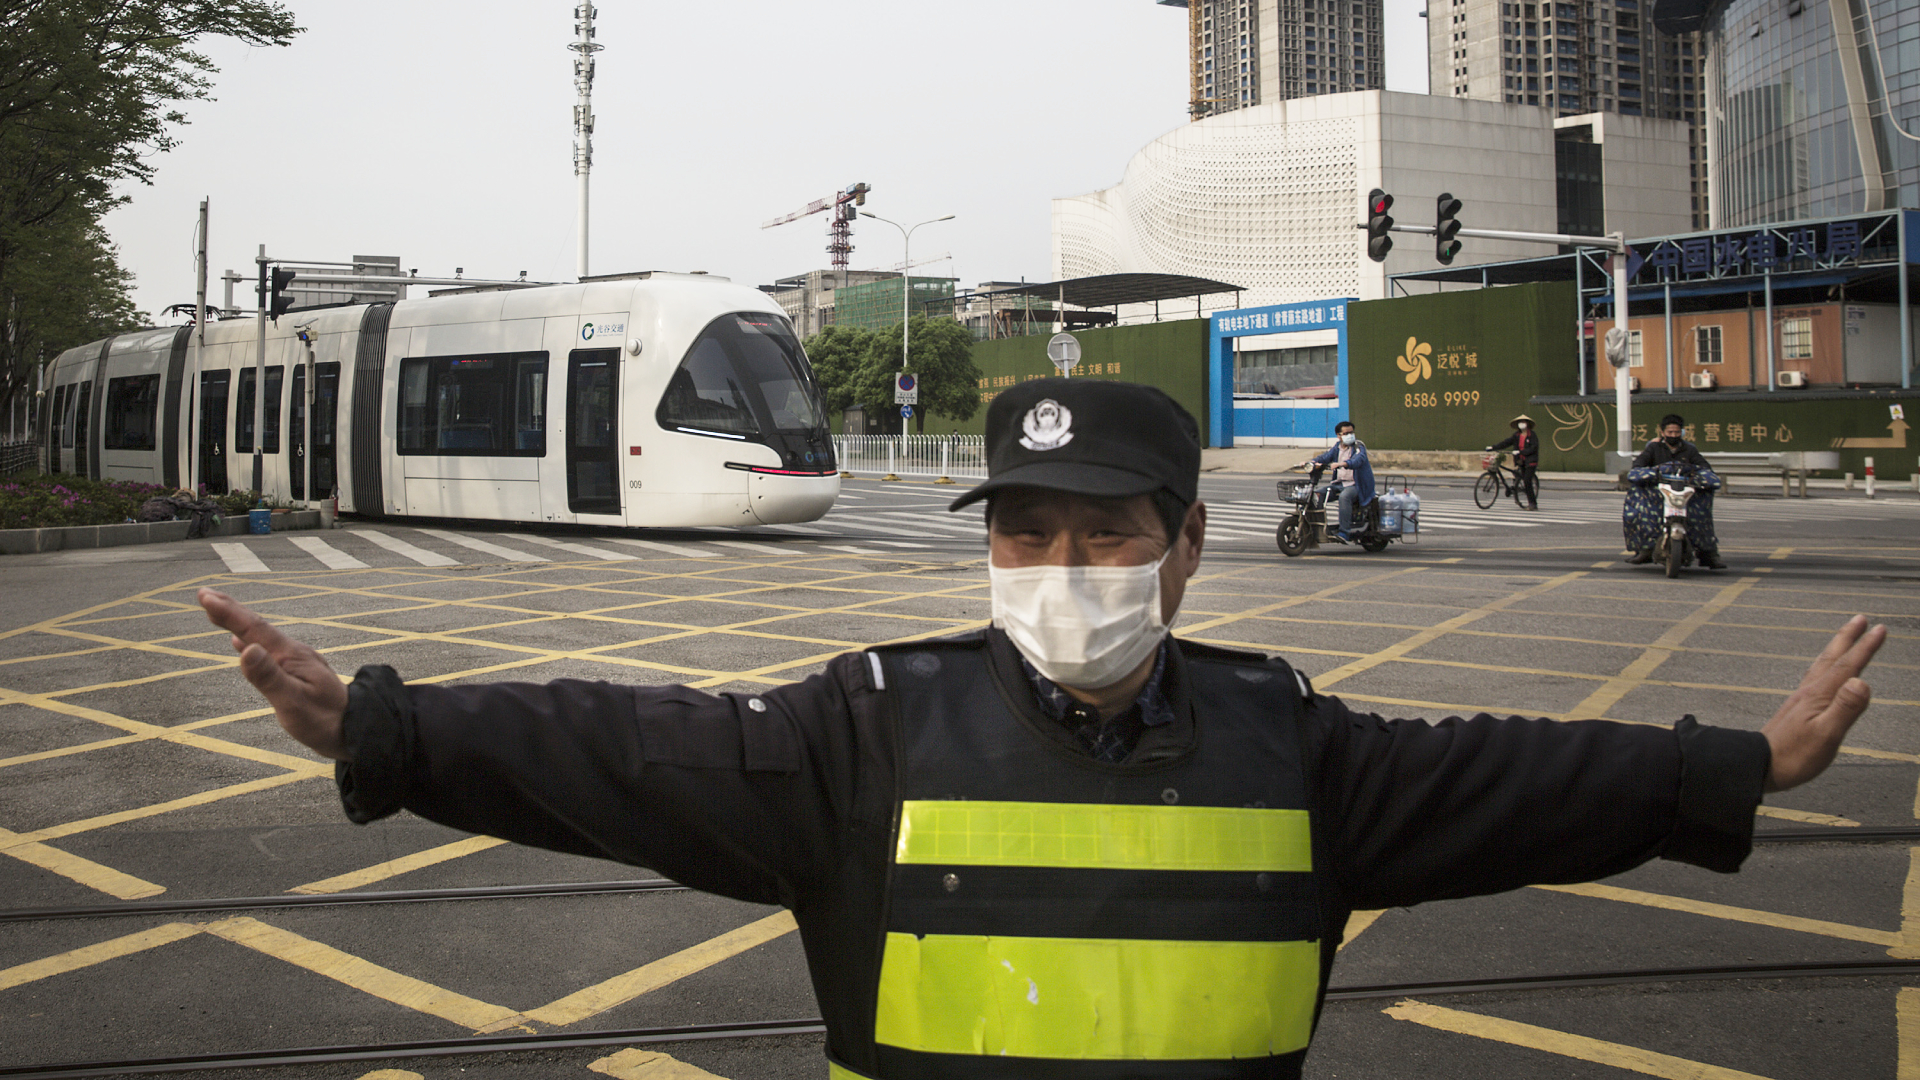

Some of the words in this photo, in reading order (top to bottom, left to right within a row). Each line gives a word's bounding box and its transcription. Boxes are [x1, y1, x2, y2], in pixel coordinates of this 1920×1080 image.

[1652, 222, 1862, 277] 中国水电八局
[597, 323, 625, 334] 光谷交通
[1404, 392, 1438, 408] 8586
[1444, 390, 1480, 406] 9999
[1632, 422, 1793, 442] 泛城营销中心
[629, 480, 642, 489] 009
